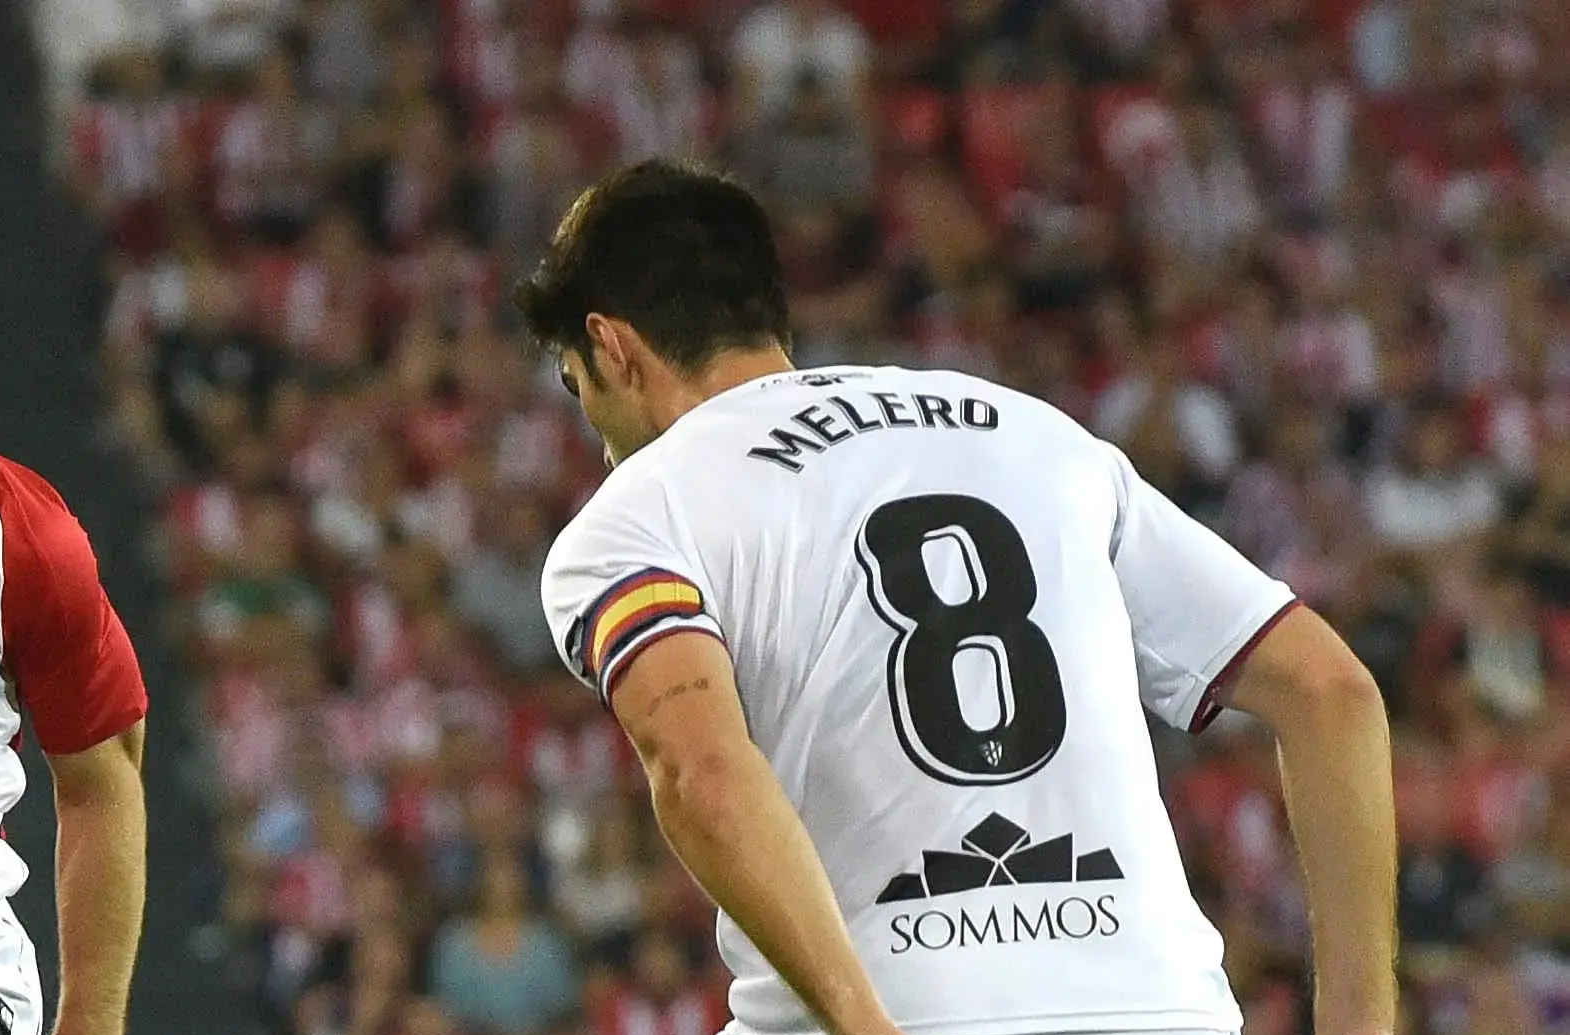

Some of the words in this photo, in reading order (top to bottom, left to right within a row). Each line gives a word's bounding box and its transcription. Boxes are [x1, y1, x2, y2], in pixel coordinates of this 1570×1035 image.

[747, 392, 999, 474] MELERO
[854, 493, 1067, 787] 8
[890, 894, 1121, 954] SOMMOS
